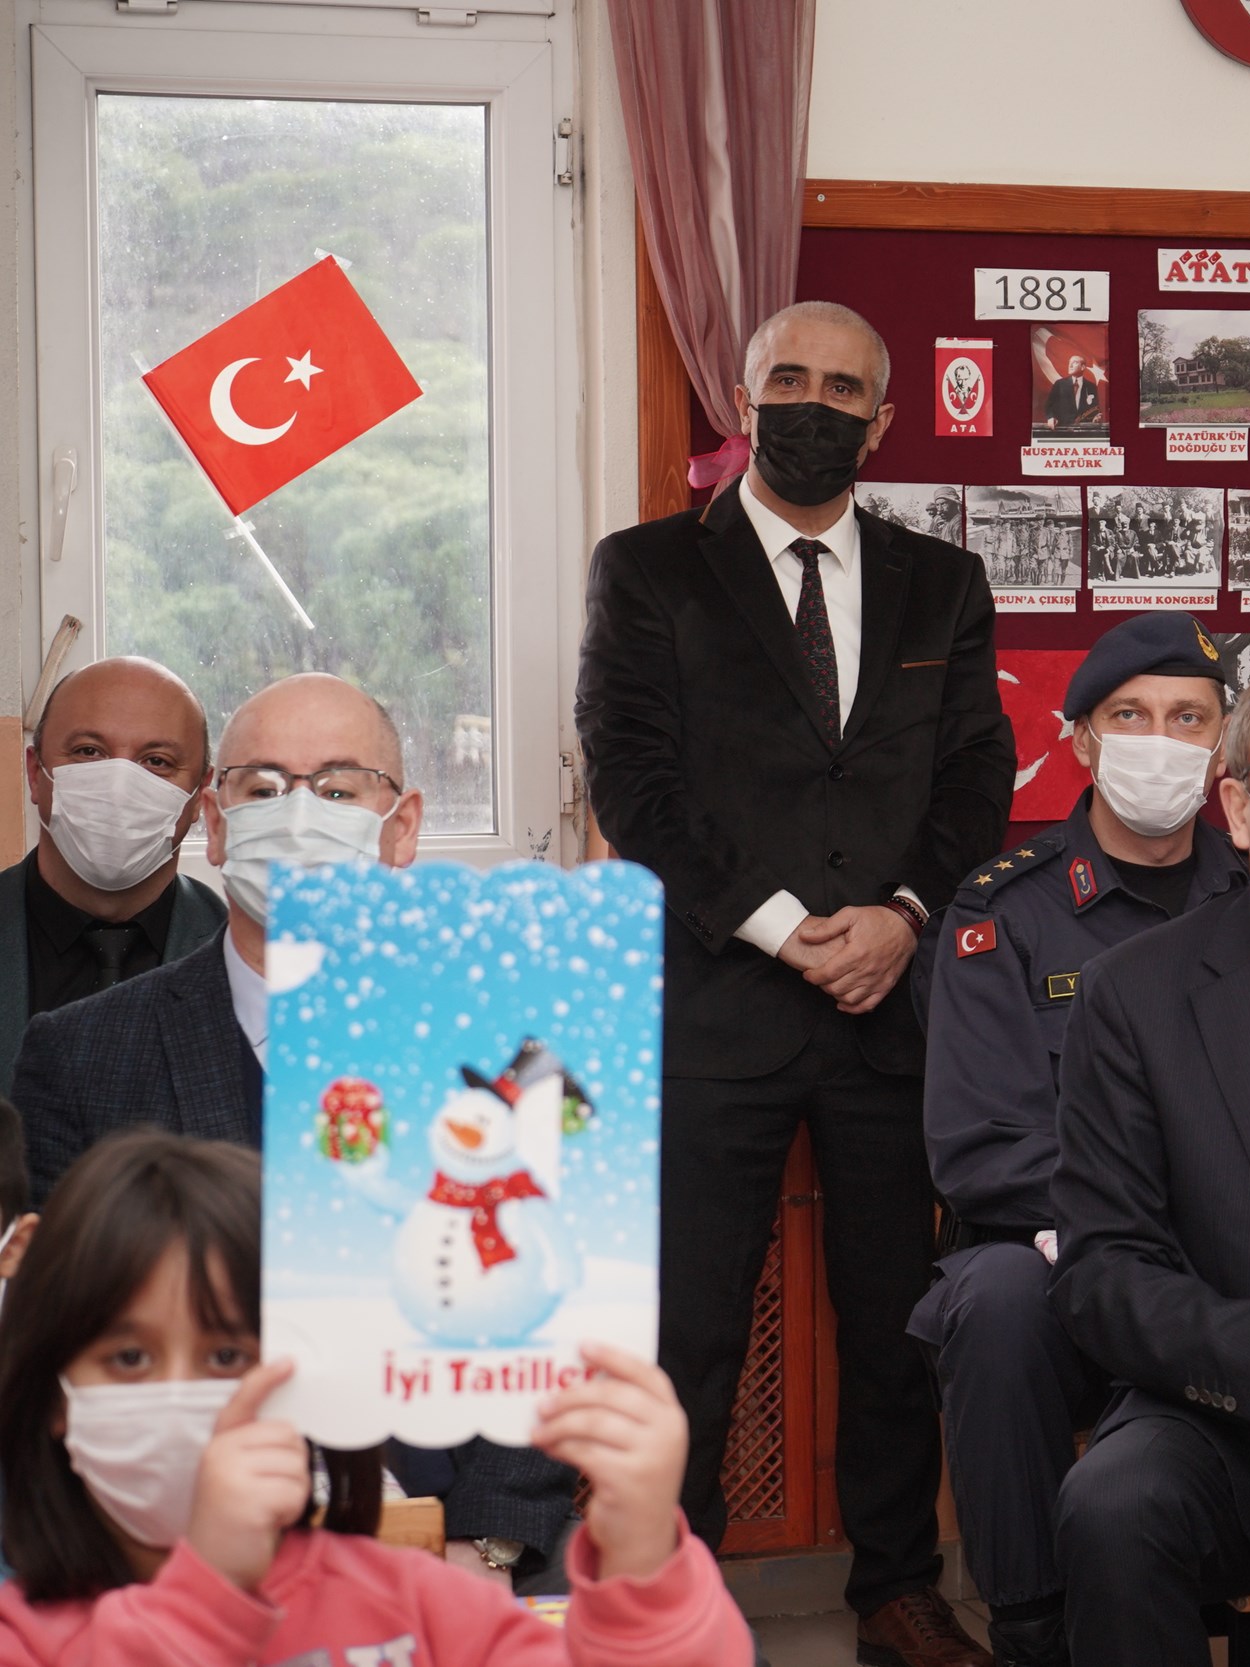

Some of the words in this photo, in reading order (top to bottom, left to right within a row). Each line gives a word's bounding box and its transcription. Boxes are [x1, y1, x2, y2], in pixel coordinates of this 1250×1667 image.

[995, 275, 1092, 312] 1881
[950, 424, 977, 433] ATA
[1168, 430, 1246, 441] ATATÜRK'ÜN
[1022, 447, 1080, 456] MUSTAFA
[1083, 447, 1125, 456] KEMAL
[1169, 442, 1227, 453] DOĞDUĞU
[1230, 444, 1246, 453] EV
[1044, 457, 1103, 468] ATATÜRK
[1038, 595, 1075, 605] ÇIKIŞI
[1094, 595, 1152, 605] ERZURUM
[1155, 594, 1215, 605] KONGRESİ
[383, 1350, 431, 1401] İyi
